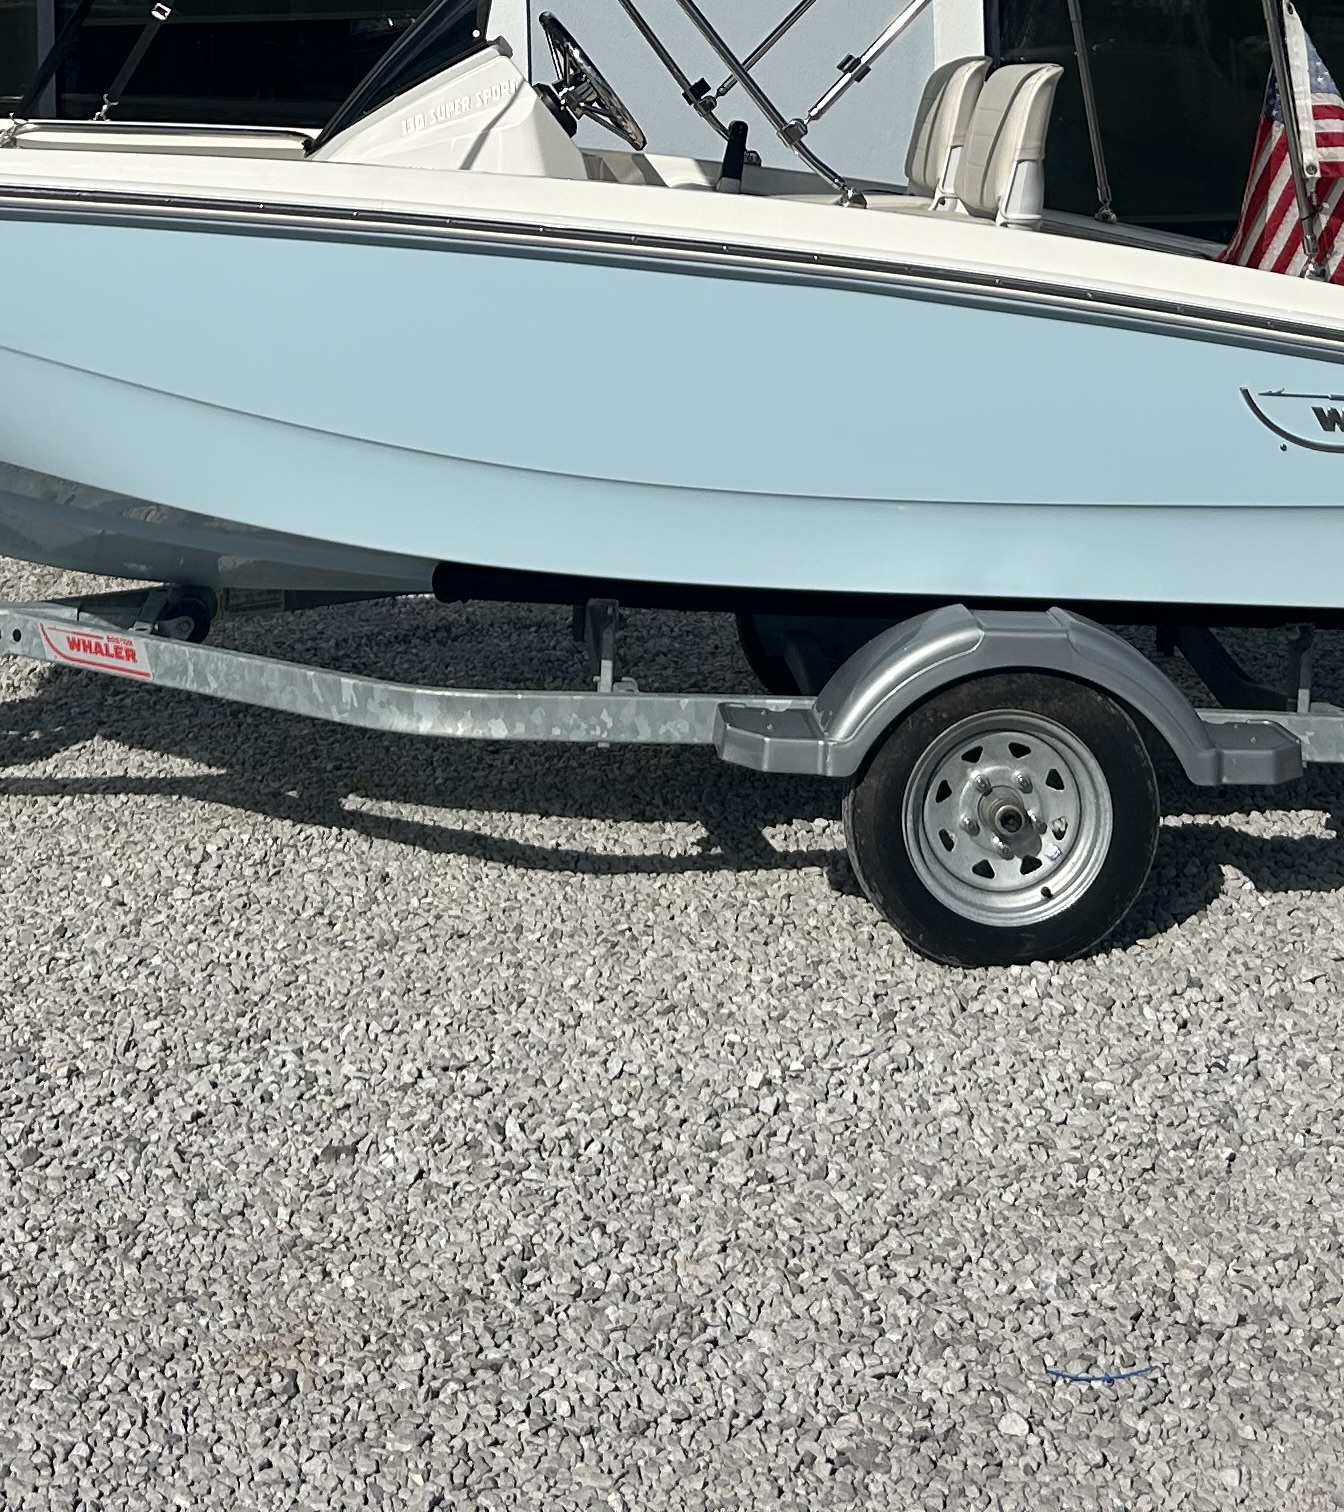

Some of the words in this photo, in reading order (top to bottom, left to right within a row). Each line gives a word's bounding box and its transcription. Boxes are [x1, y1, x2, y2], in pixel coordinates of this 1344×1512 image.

[401, 112, 426, 136] 130
[429, 95, 472, 125] SUPER
[66, 636, 138, 663] WHALER
